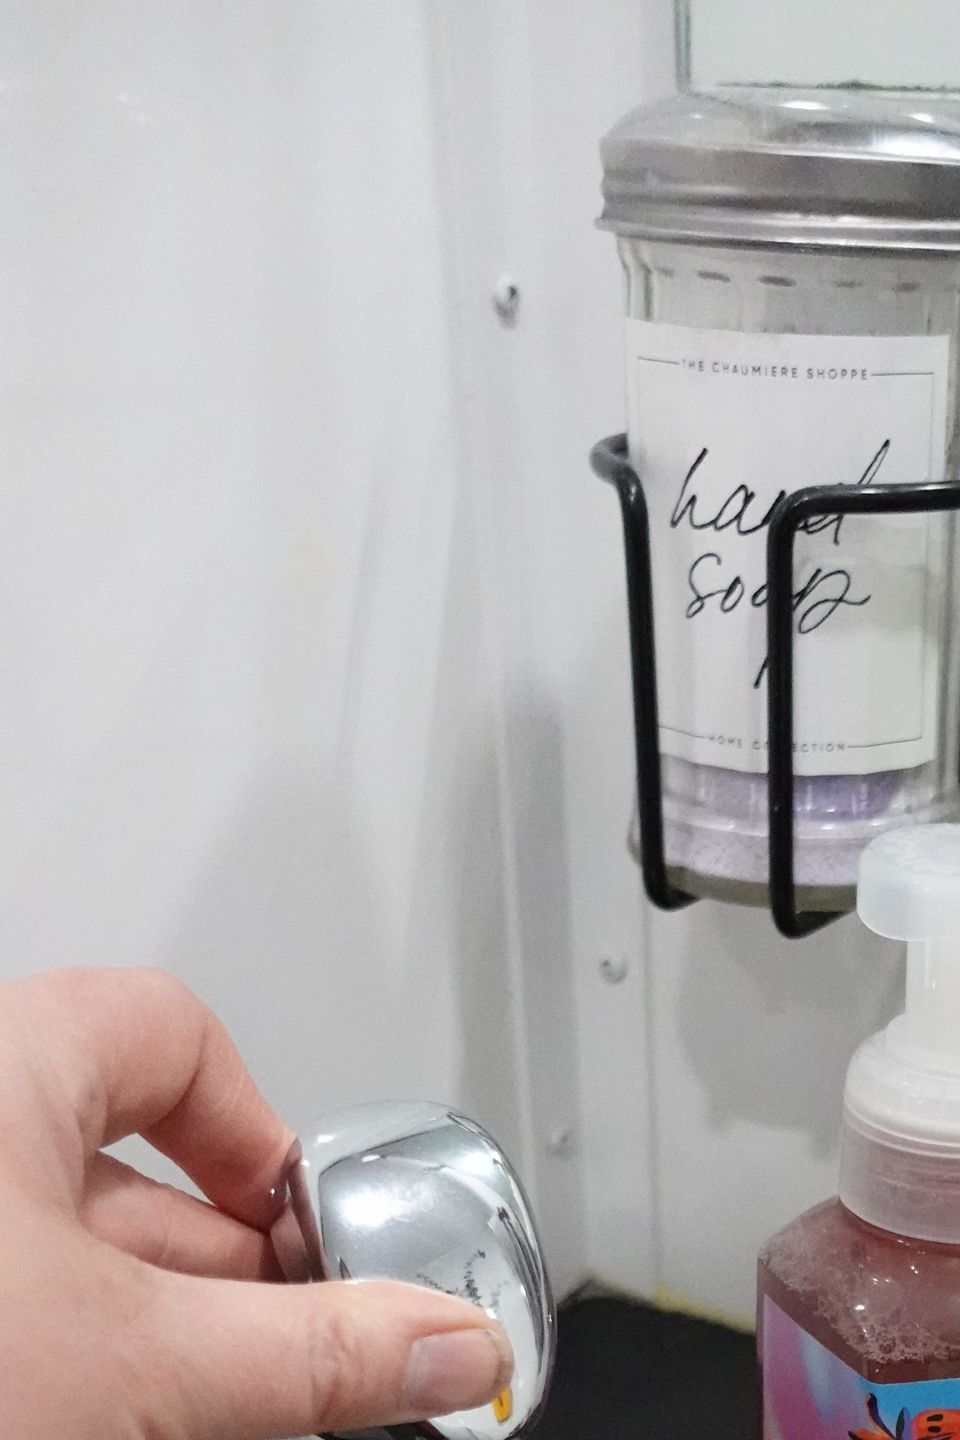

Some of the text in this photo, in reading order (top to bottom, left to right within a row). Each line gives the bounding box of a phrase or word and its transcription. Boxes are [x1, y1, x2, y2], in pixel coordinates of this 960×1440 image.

[681, 359, 867, 380] THE CHAUMIERE SHOPPE
